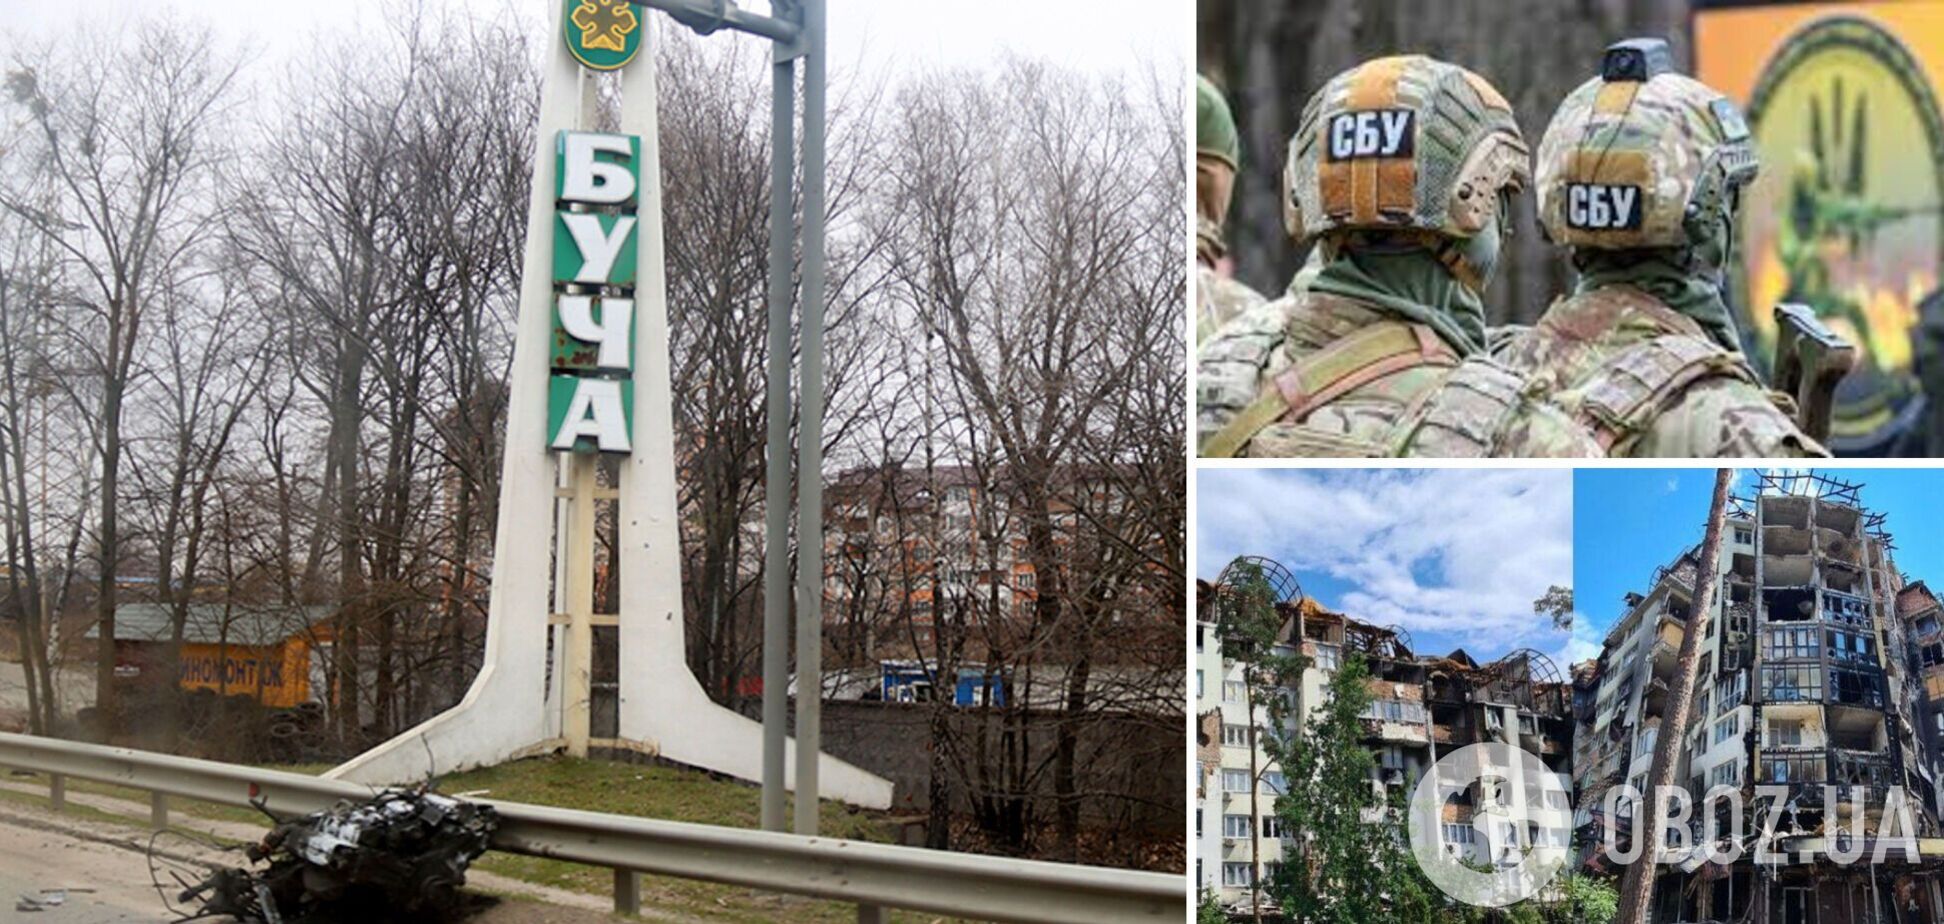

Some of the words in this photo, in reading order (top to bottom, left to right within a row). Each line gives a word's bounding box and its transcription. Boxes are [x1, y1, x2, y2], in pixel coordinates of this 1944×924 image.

[1331, 110, 1408, 158] СБУ
[1568, 184, 1637, 228] СБУ
[551, 132, 637, 451] БУЧА
